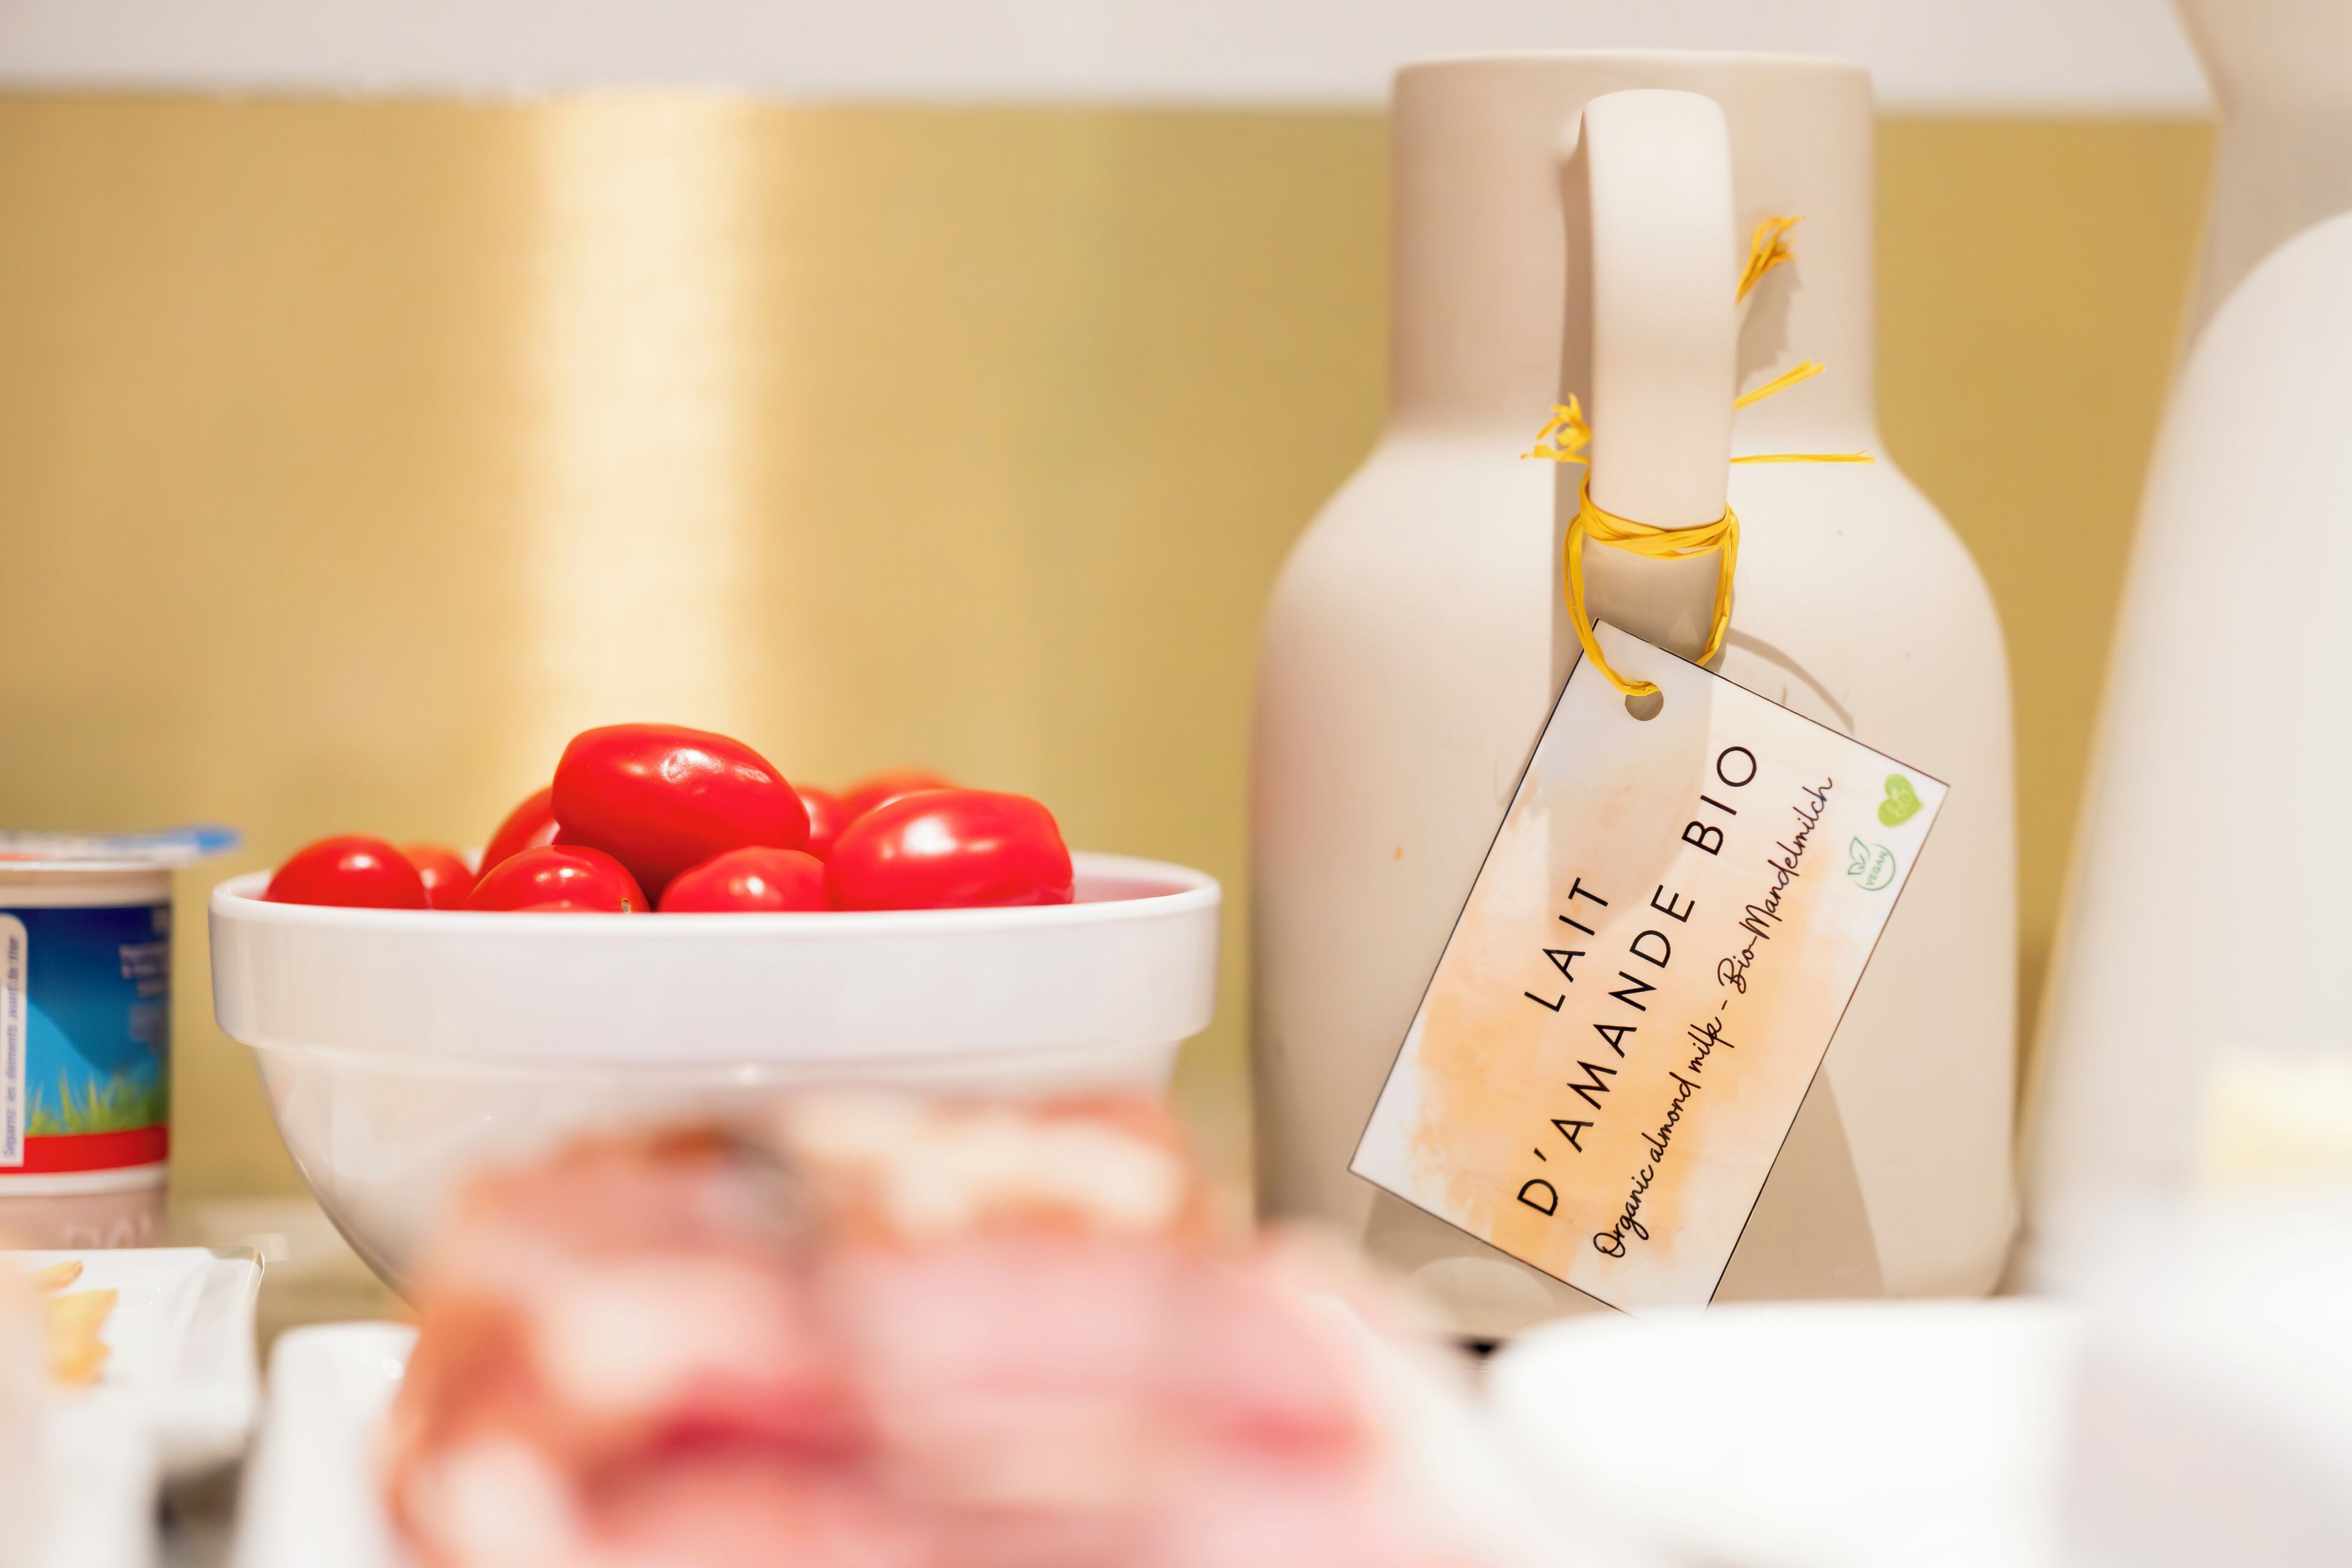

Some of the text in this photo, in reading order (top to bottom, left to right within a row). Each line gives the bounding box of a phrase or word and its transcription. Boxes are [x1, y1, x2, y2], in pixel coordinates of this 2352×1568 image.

[1517, 746, 1757, 1217] D'AMANDE BIO
[1524, 877, 1609, 1012] LAIT
[1593, 1164, 1654, 1259] Organic
[1642, 1071, 1702, 1163] almond
[1687, 1017, 1735, 1074] milk
[1717, 777, 1833, 995] Bio-Mandelmilch
[1866, 850, 1889, 886] VEGAN
